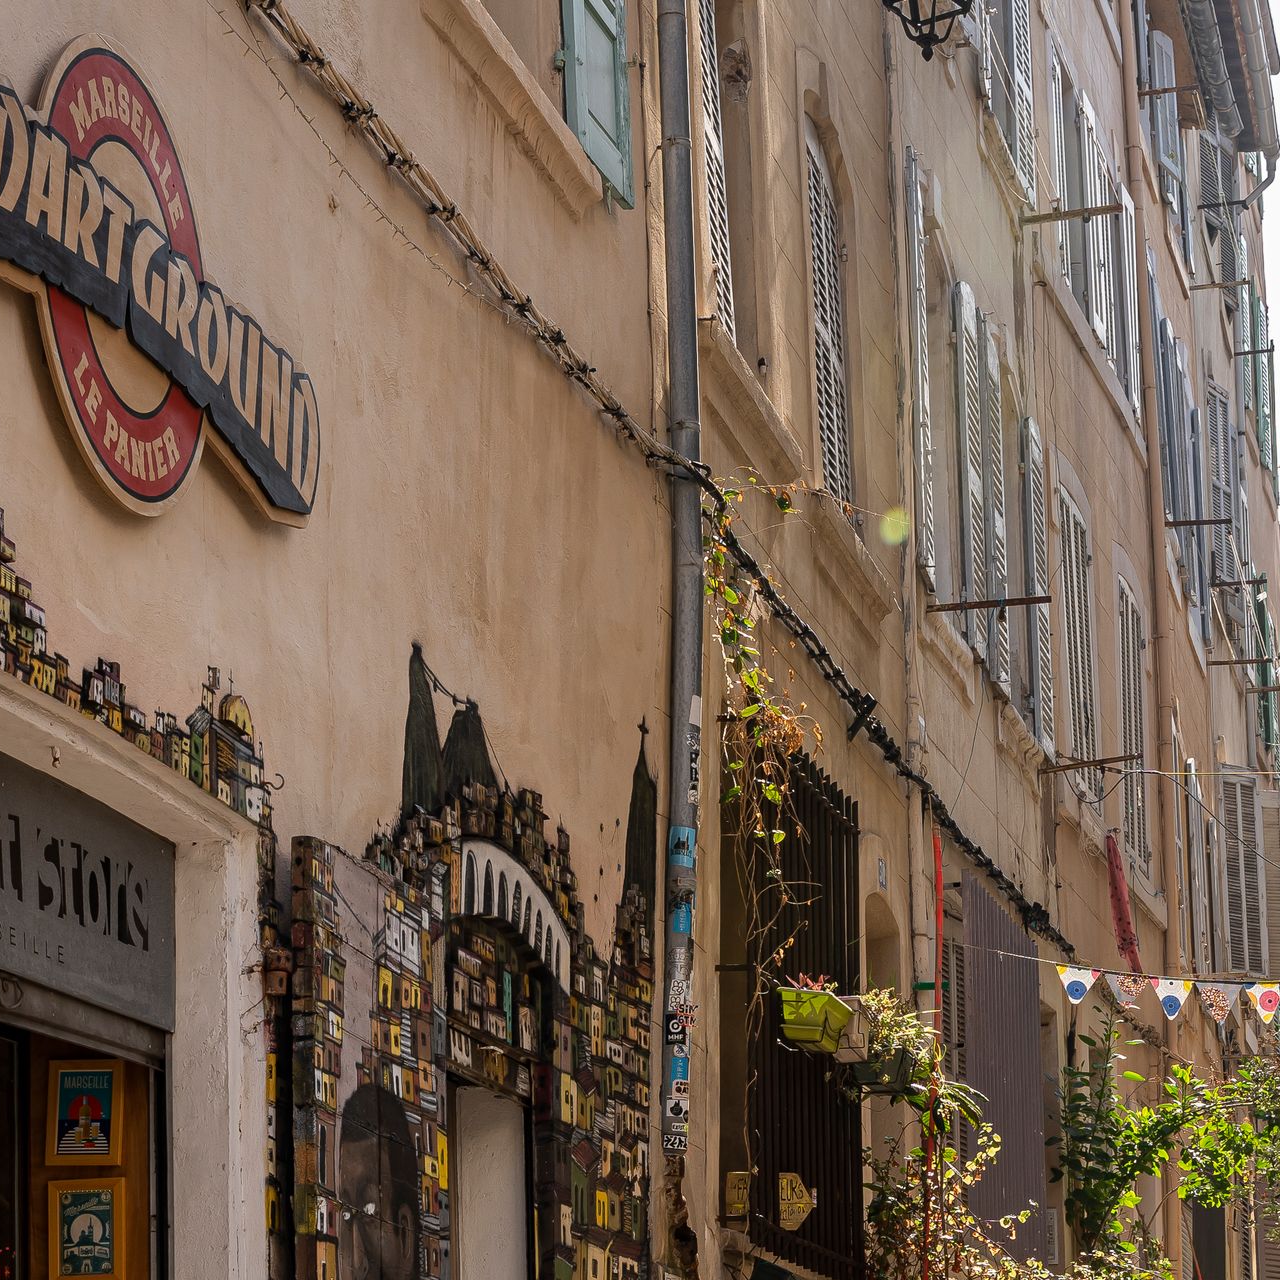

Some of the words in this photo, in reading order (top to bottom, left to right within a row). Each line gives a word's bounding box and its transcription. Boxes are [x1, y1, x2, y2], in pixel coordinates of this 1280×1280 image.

[70, 77, 185, 230] MARSEILLE
[73, 351, 105, 425] LE
[103, 414, 181, 483] PANIER
[131, 224, 320, 505] GROUND
[64, 1075, 110, 1089] MARSEILLE
